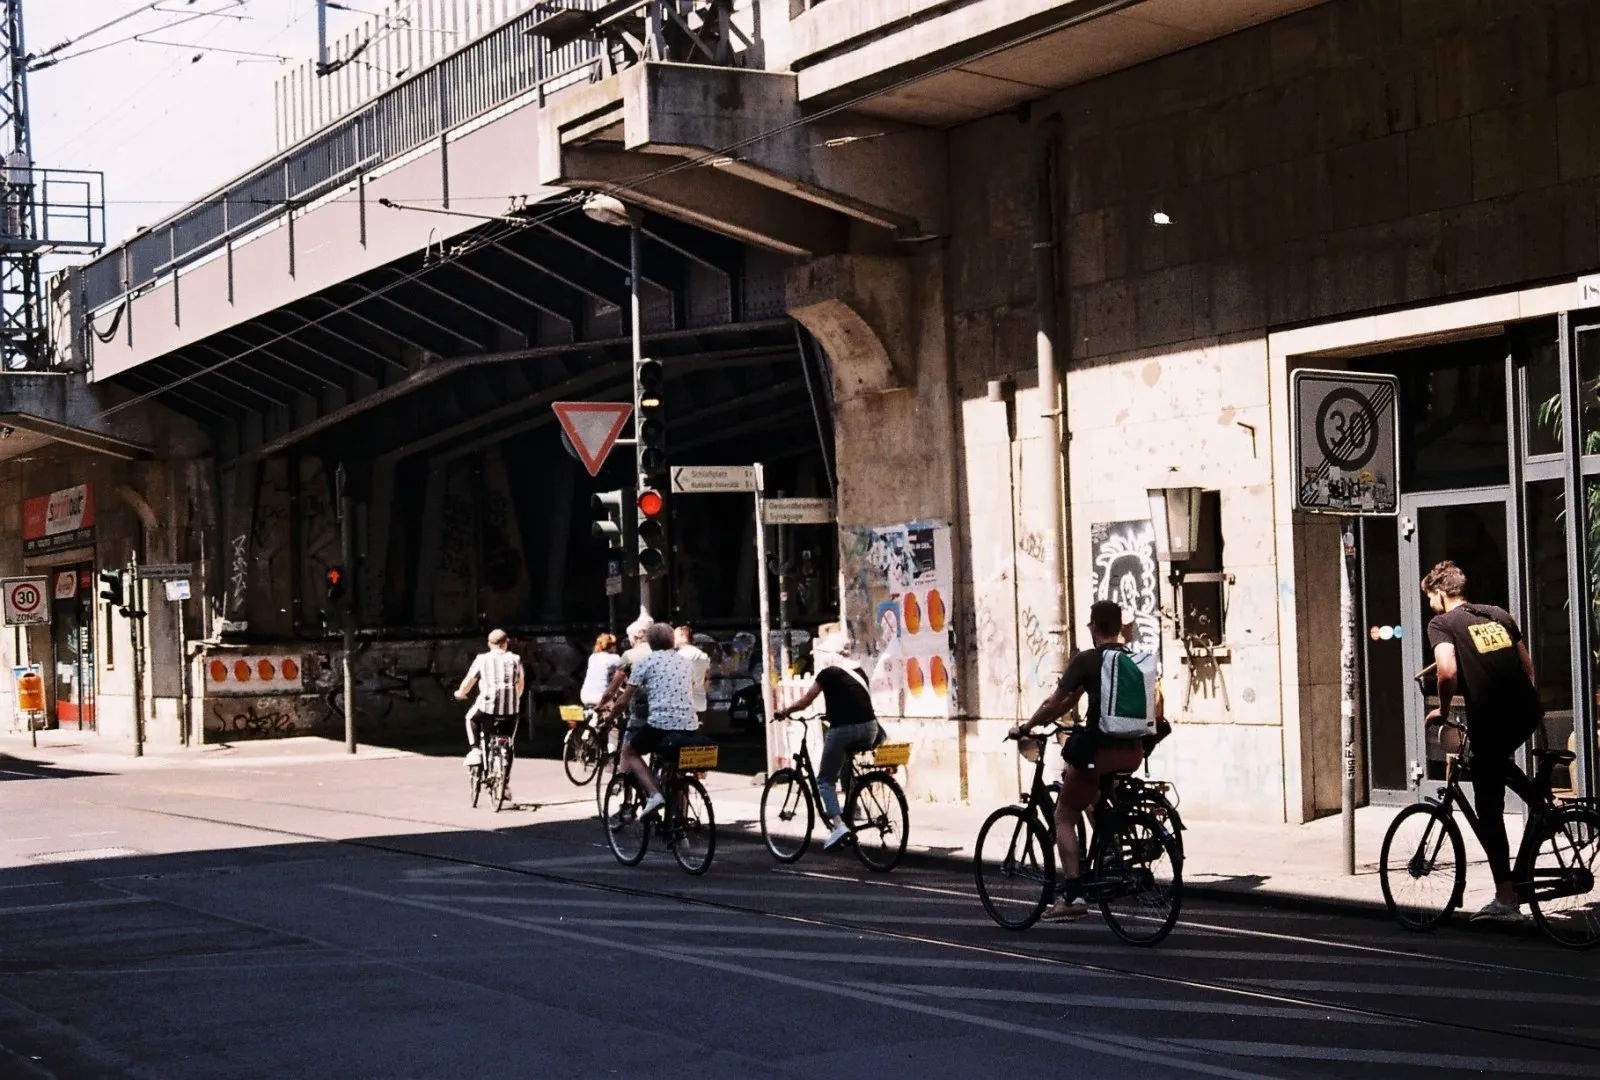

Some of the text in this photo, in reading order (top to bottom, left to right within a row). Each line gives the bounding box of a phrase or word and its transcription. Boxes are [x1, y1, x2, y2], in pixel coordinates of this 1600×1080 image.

[1329, 410, 1365, 451] 30
[18, 591, 34, 605] 30
[16, 612, 38, 622] ZONE
[1482, 633, 1504, 646] DAT
